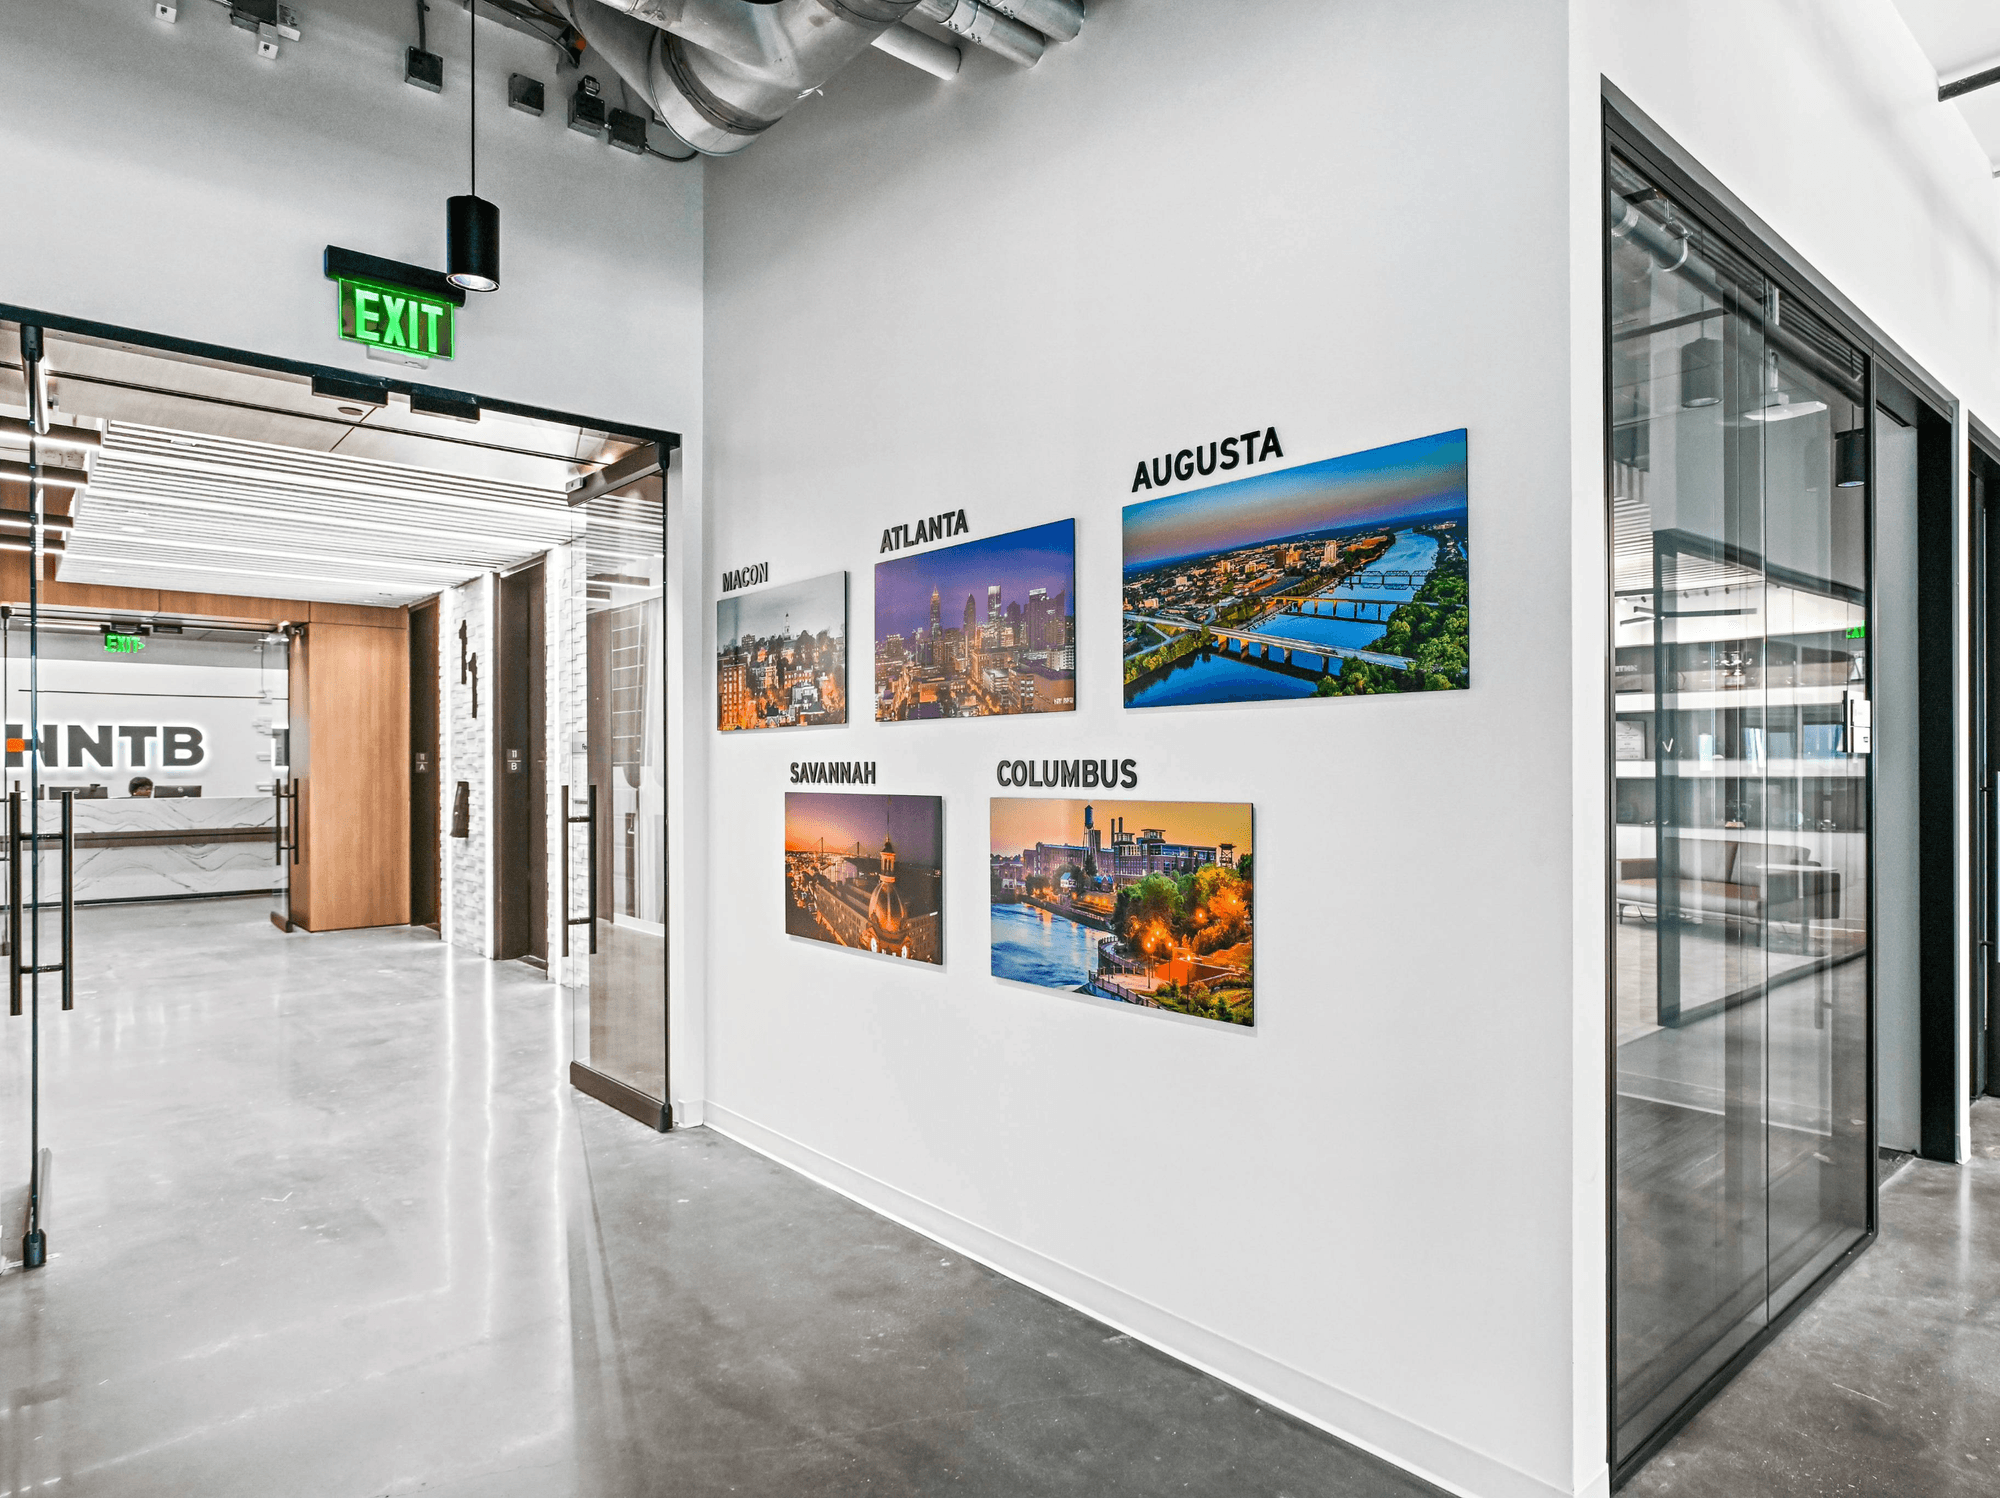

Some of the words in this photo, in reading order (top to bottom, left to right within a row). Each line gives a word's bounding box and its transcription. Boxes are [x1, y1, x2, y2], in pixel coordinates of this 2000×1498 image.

[355, 288, 443, 353] EXIT
[1131, 426, 1284, 493] AUGUSTA
[880, 509, 969, 553] ATLANTA
[722, 561, 768, 592] MACON
[105, 635, 140, 653] EXIT
[5, 724, 205, 767] HNTB
[511, 762, 518, 771] B
[790, 761, 876, 785] SAVANNAH
[997, 759, 1138, 789] COLUMBUS
